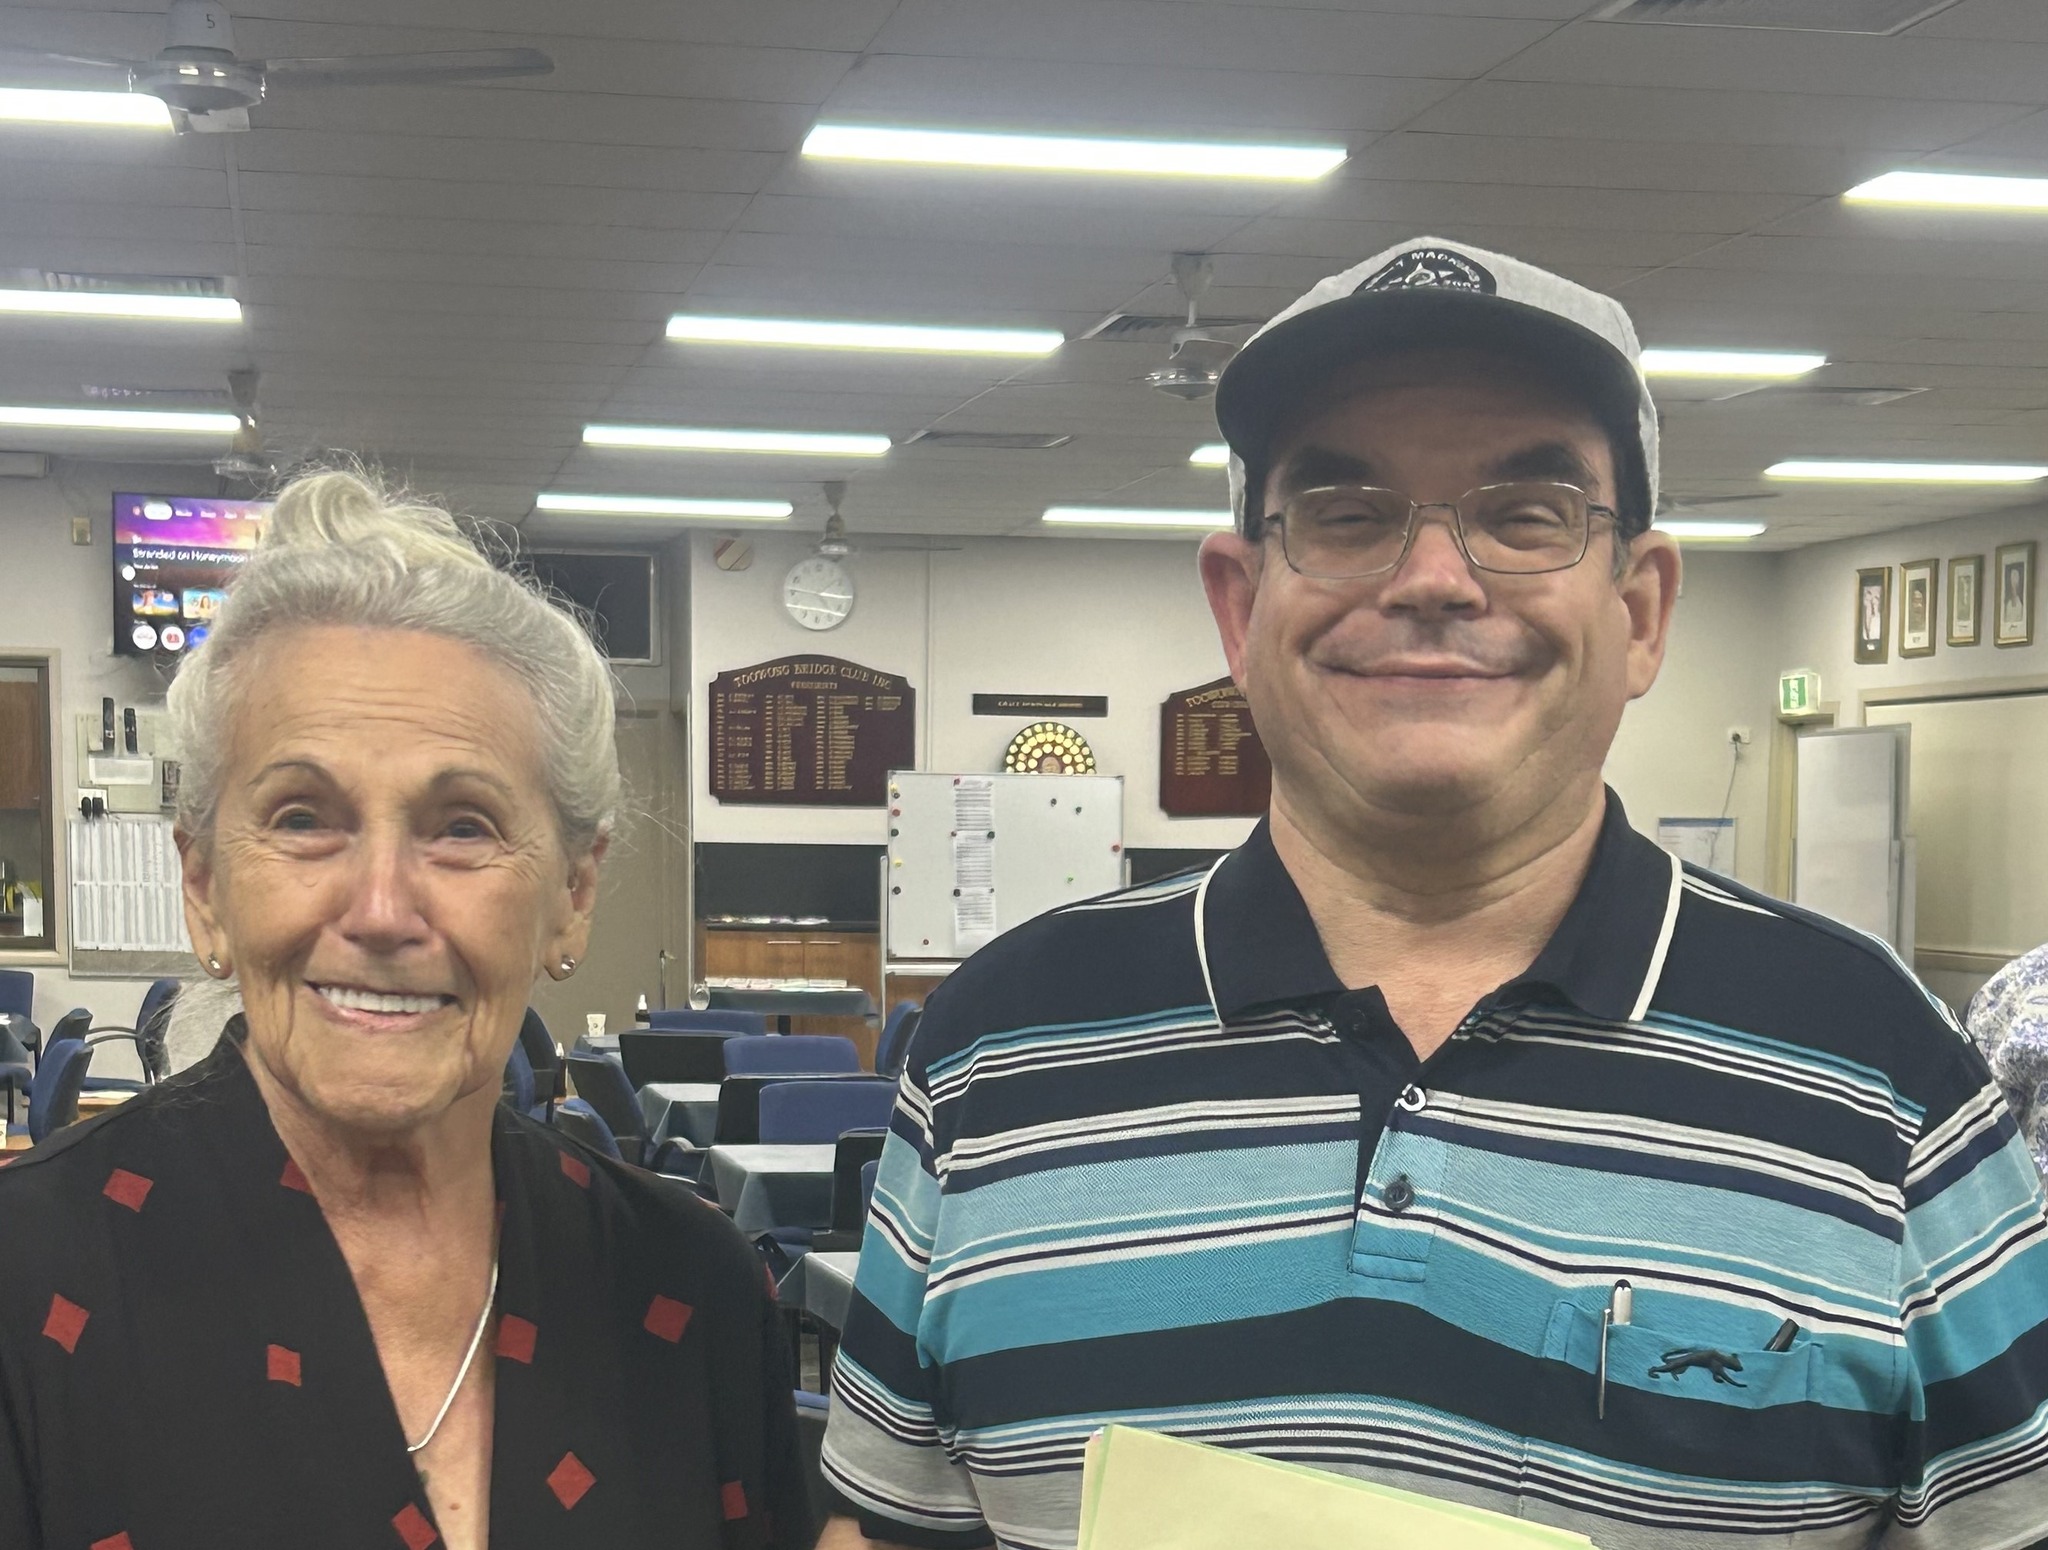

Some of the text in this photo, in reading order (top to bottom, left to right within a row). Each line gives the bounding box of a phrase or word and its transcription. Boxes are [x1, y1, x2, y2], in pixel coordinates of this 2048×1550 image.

[206, 13, 216, 29] 5
[794, 664, 837, 677] BRIDGE
[841, 667, 870, 682] CLUB
